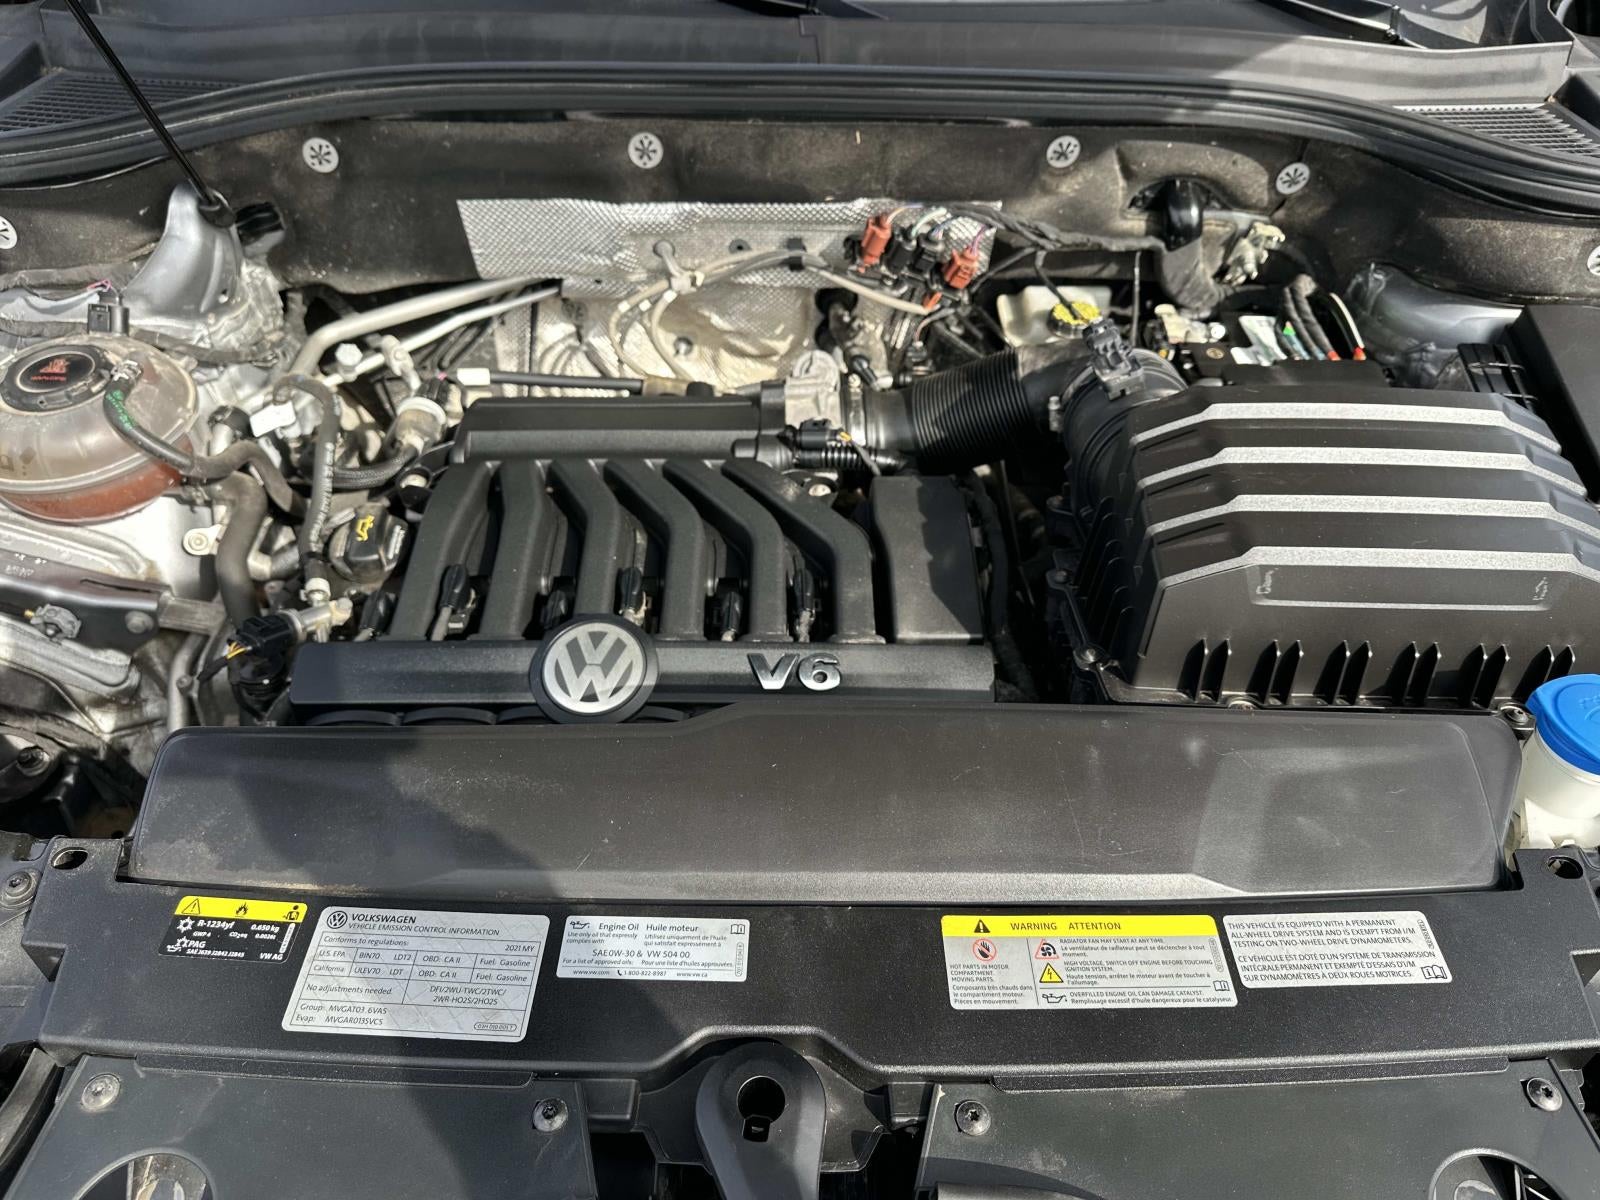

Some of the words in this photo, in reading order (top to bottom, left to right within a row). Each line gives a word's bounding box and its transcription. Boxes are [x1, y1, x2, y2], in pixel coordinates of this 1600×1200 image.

[747, 652, 841, 691] V6
[352, 914, 416, 923] VOLKSWAGEN
[197, 920, 235, 929] R-1234yf
[270, 925, 280, 933] kg
[599, 923, 625, 931] Engine
[1068, 922, 1121, 930] ATTENTION
[448, 927, 500, 936] INFORMATION
[324, 936, 357, 944] Conforms
[500, 959, 530, 967] Gasoline
[318, 985, 363, 993] adjustments
